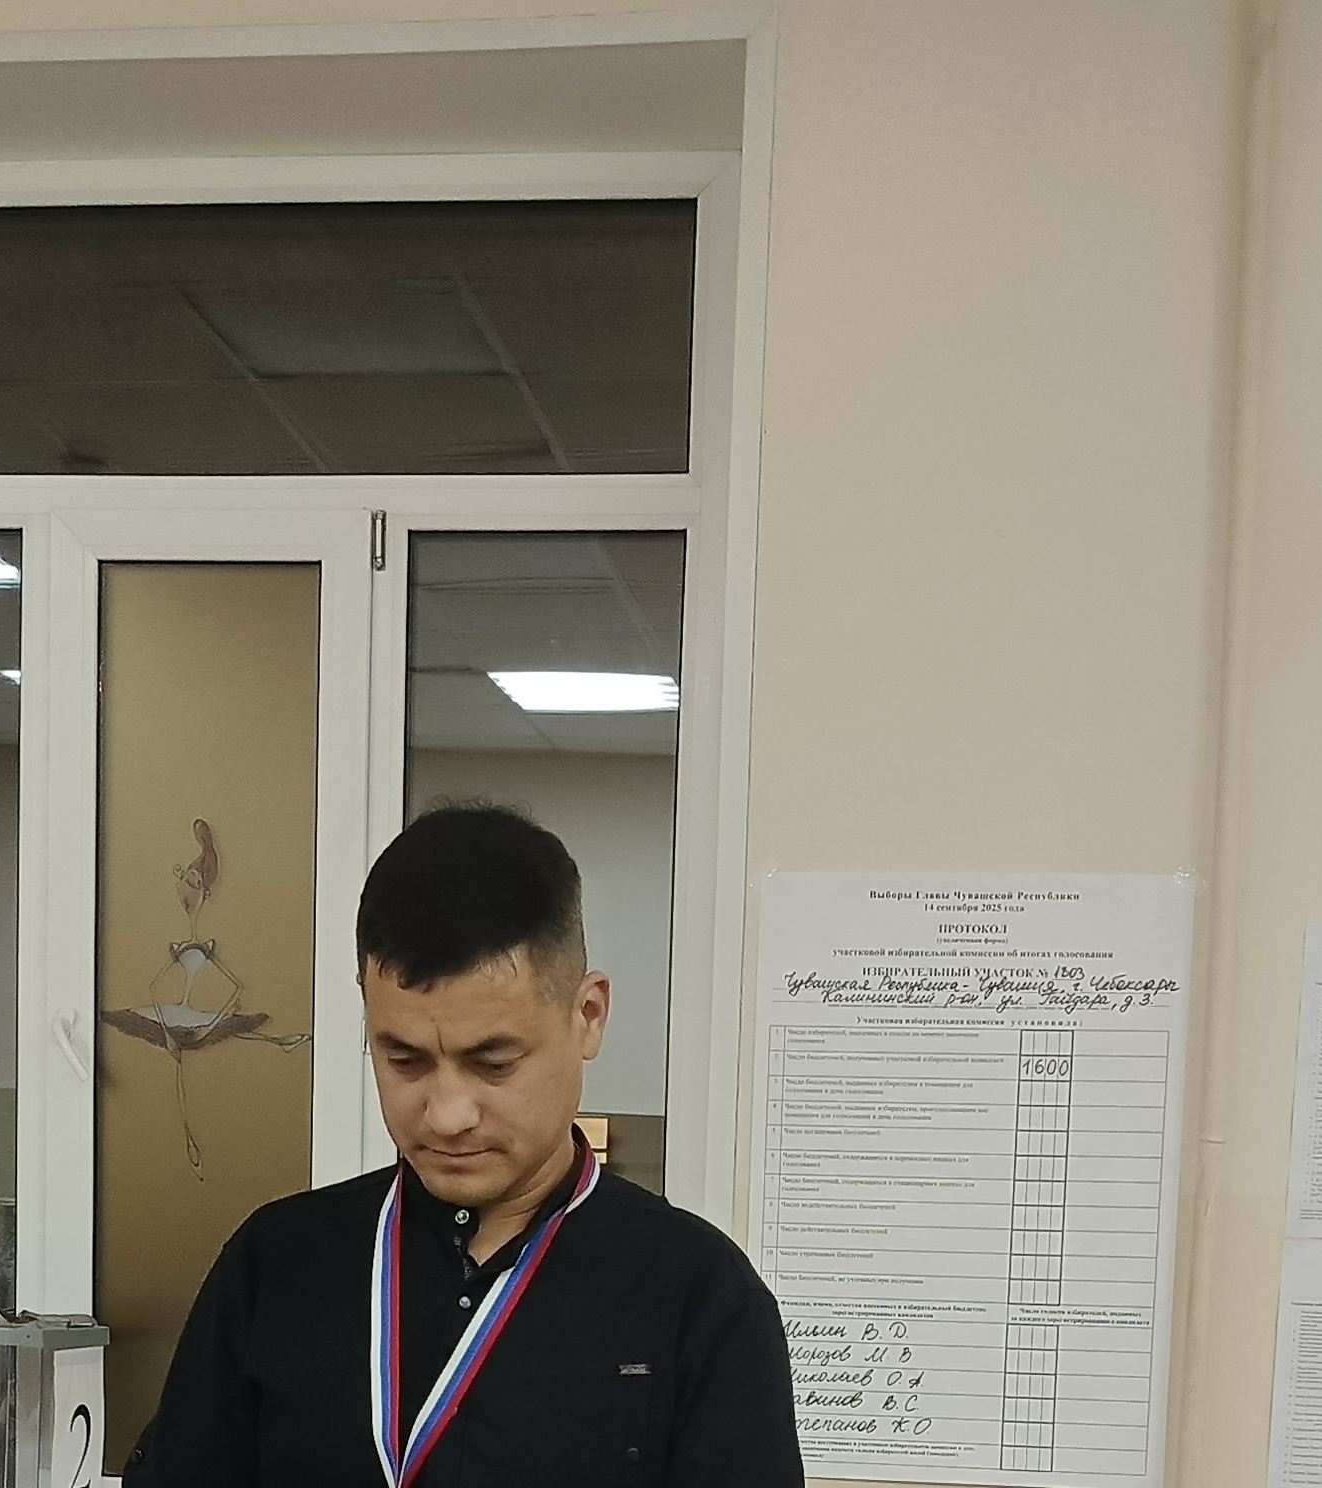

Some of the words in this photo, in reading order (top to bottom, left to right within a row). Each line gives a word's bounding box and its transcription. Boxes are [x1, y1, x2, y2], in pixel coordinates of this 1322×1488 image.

[869, 890, 912, 900] Выборы
[916, 891, 950, 900] Главы
[954, 890, 1013, 901] Чувашской
[1017, 891, 1080, 902] Республики
[924, 903, 934, 911] 14
[936, 903, 978, 913] сентября
[981, 904, 1002, 912] 2025
[939, 924, 1008, 934] ПРОТОКОЛ
[832, 948, 885, 958] участковой
[888, 949, 957, 958] избирательной
[1007, 950, 1018, 958] об
[1054, 951, 1114, 959] голосования
[862, 967, 971, 977] ИЗБИРАТЕЛЬНЫЙ
[974, 967, 1034, 978] УЧАСТОК
[784, 971, 871, 996] Чувашская
[856, 1016, 903, 1026] Участковая
[1022, 1057, 1069, 1077] 1600
[782, 1319, 848, 1339] Ильин
[793, 1391, 863, 1408] авинов
[796, 1417, 878, 1434] тепанов
